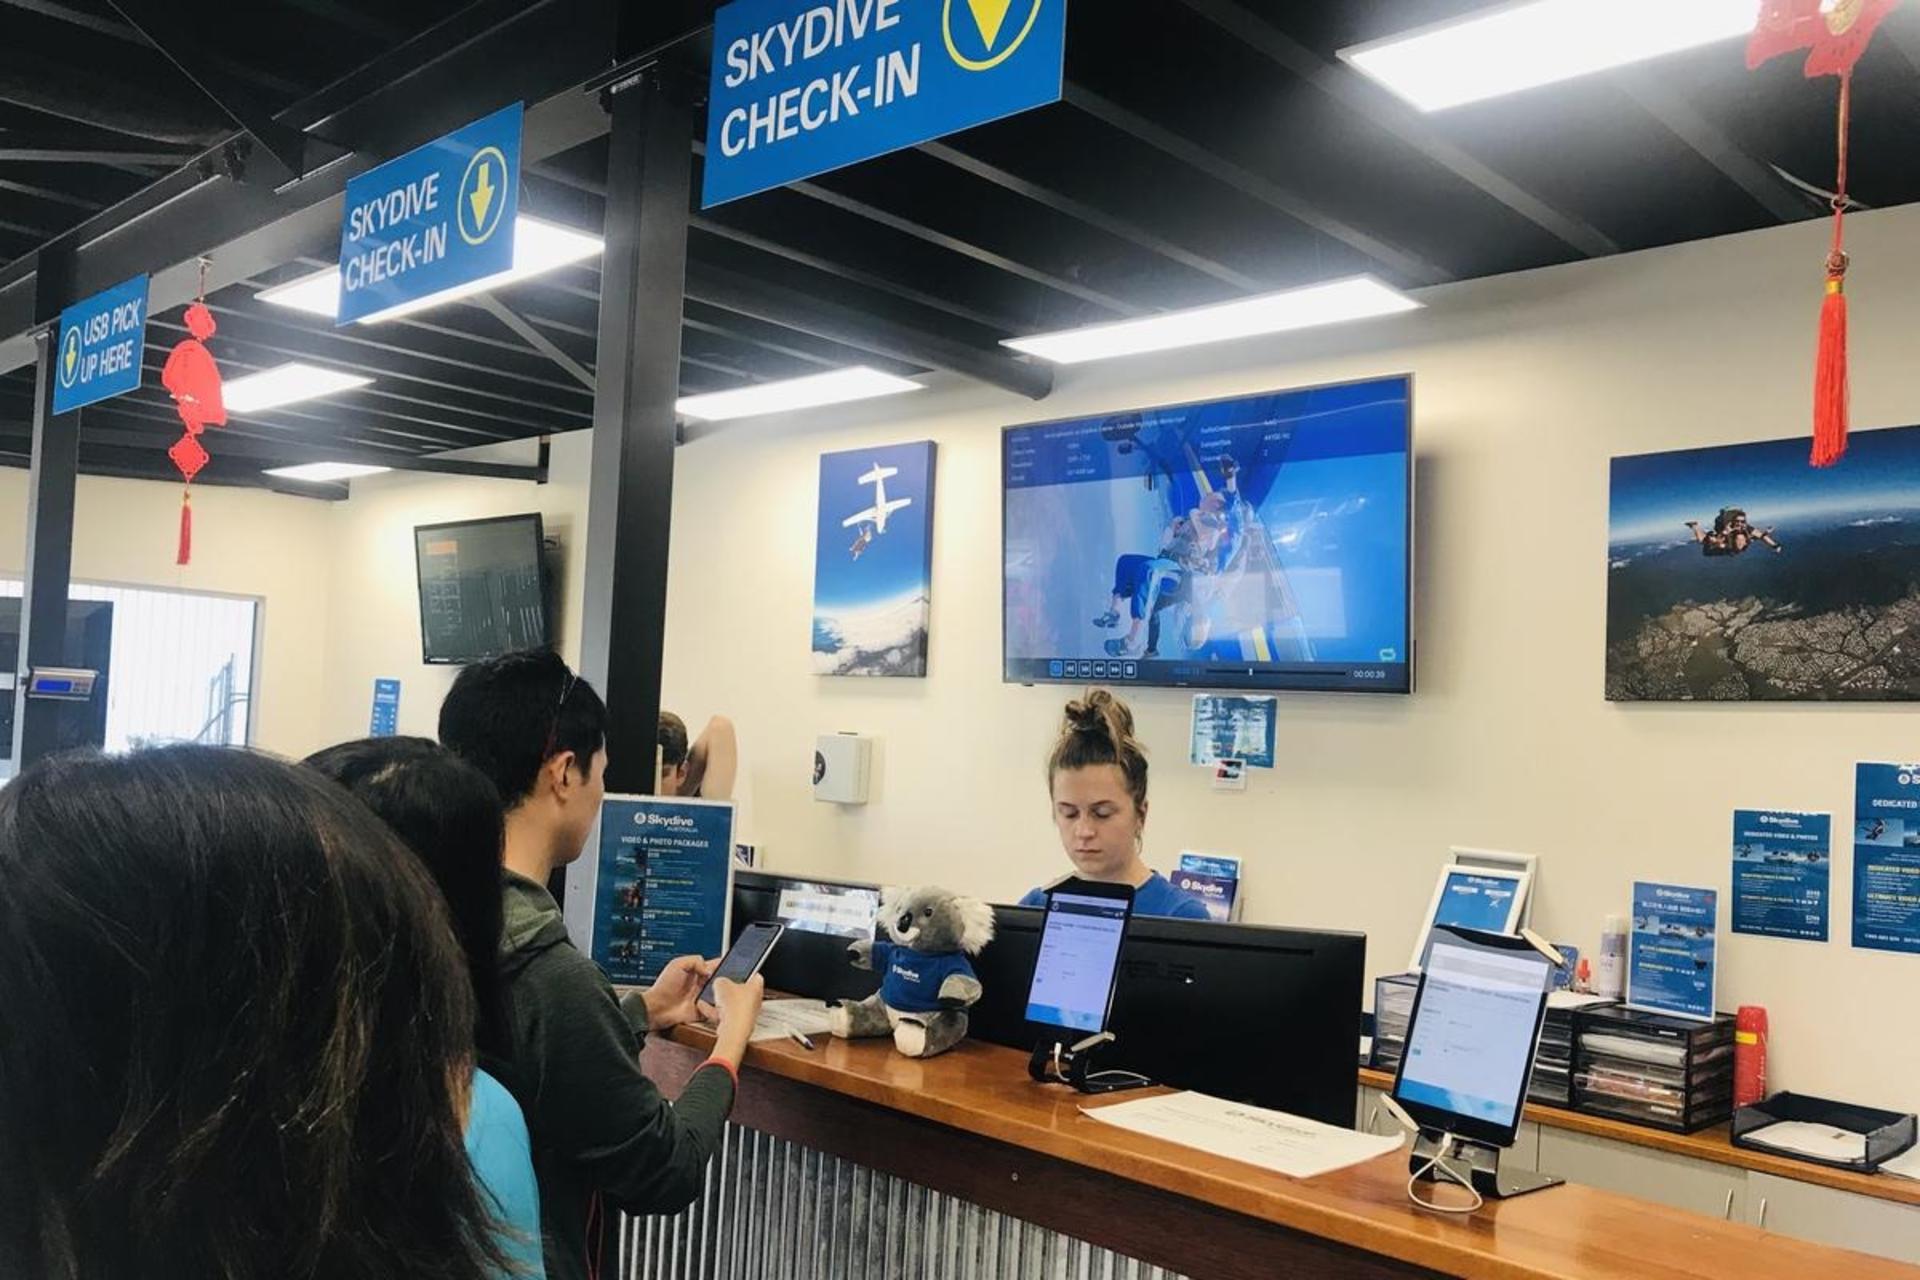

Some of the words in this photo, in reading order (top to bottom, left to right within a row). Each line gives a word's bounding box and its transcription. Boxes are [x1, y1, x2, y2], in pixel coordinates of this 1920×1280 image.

[724, 0, 900, 88] SKYDIVE
[720, 43, 920, 157] CHECK-IN
[349, 172, 440, 242] SKYDIVE
[345, 222, 447, 291] CHECK-IN
[84, 312, 109, 346] USB
[111, 298, 141, 335] PICK
[81, 353, 98, 383] UP
[99, 340, 134, 376] HERE
[647, 813, 694, 827] Skydive
[1872, 799, 1918, 809] DEDICATED
[621, 836, 642, 845] VIDEO
[643, 836, 649, 845] &
[650, 837, 673, 847] PHOTO
[673, 839, 710, 849] PACKAGES
